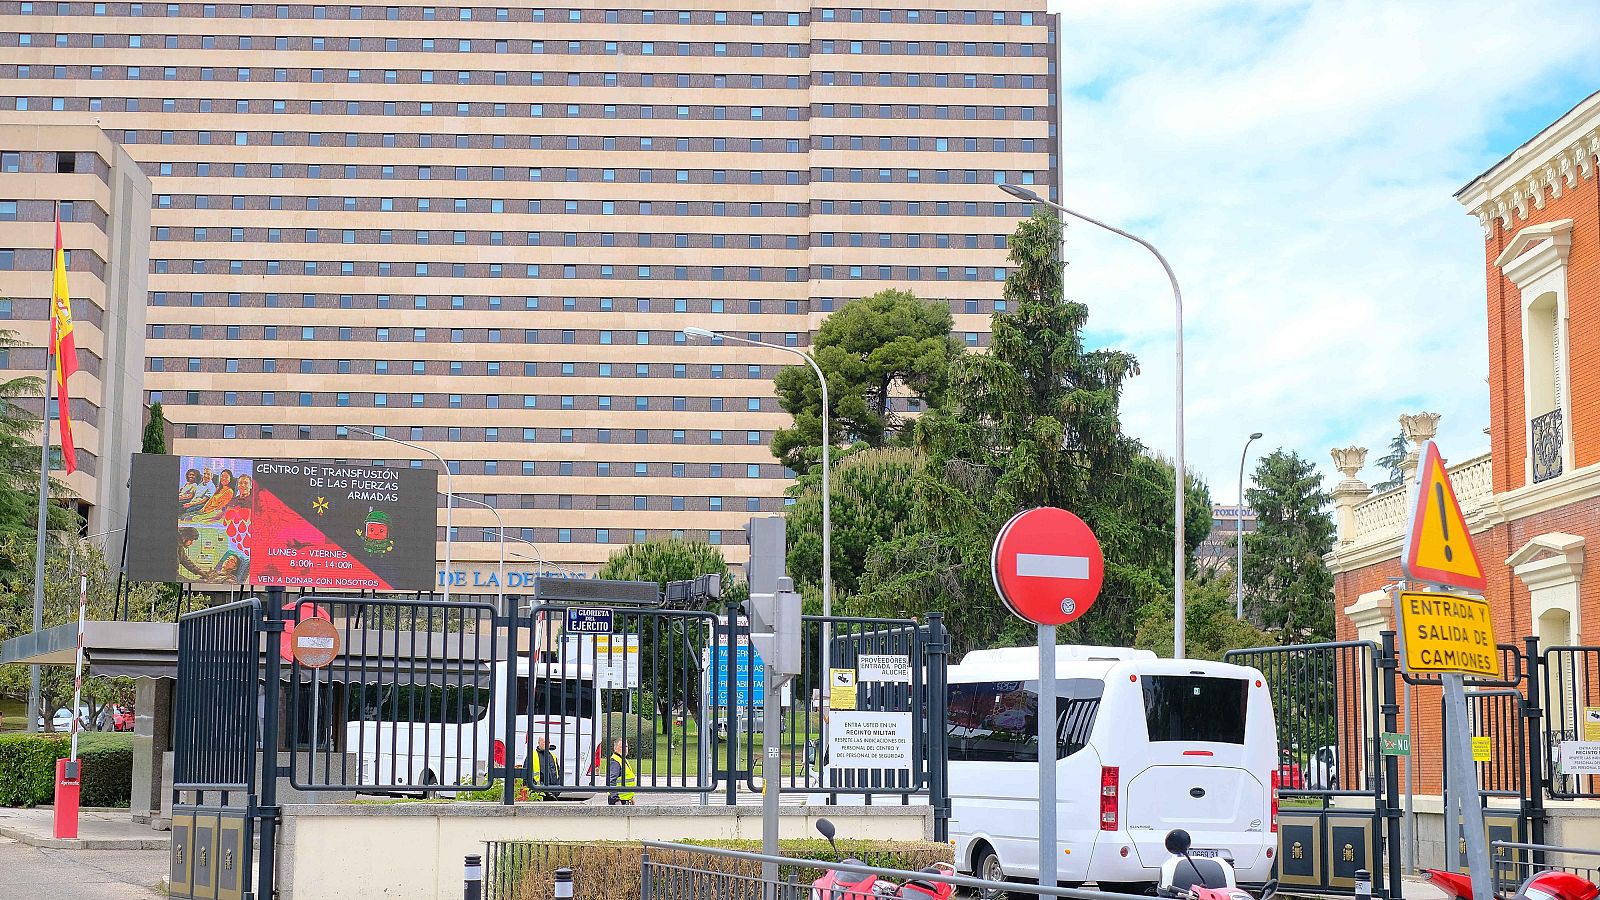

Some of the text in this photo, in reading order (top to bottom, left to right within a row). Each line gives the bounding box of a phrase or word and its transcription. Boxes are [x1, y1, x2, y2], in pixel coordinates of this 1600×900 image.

[256, 464, 398, 480] CENTRO DE TRANSFUSIÓN
[310, 478, 398, 490] DE LAS FUERZAS
[348, 492, 398, 501] ARMADAS
[268, 548, 297, 556] LUNES
[309, 550, 347, 558] VIERNES
[325, 560, 352, 568] 14:00h
[438, 570, 467, 586] DE
[473, 572, 500, 587] LA
[1410, 600, 1485, 623] ENTRADA Y
[572, 621, 608, 631] EJERCITO
[1418, 625, 1488, 646] SALIDA DE
[1421, 650, 1490, 669] CAMIONES
[1398, 740, 1408, 750] NO
